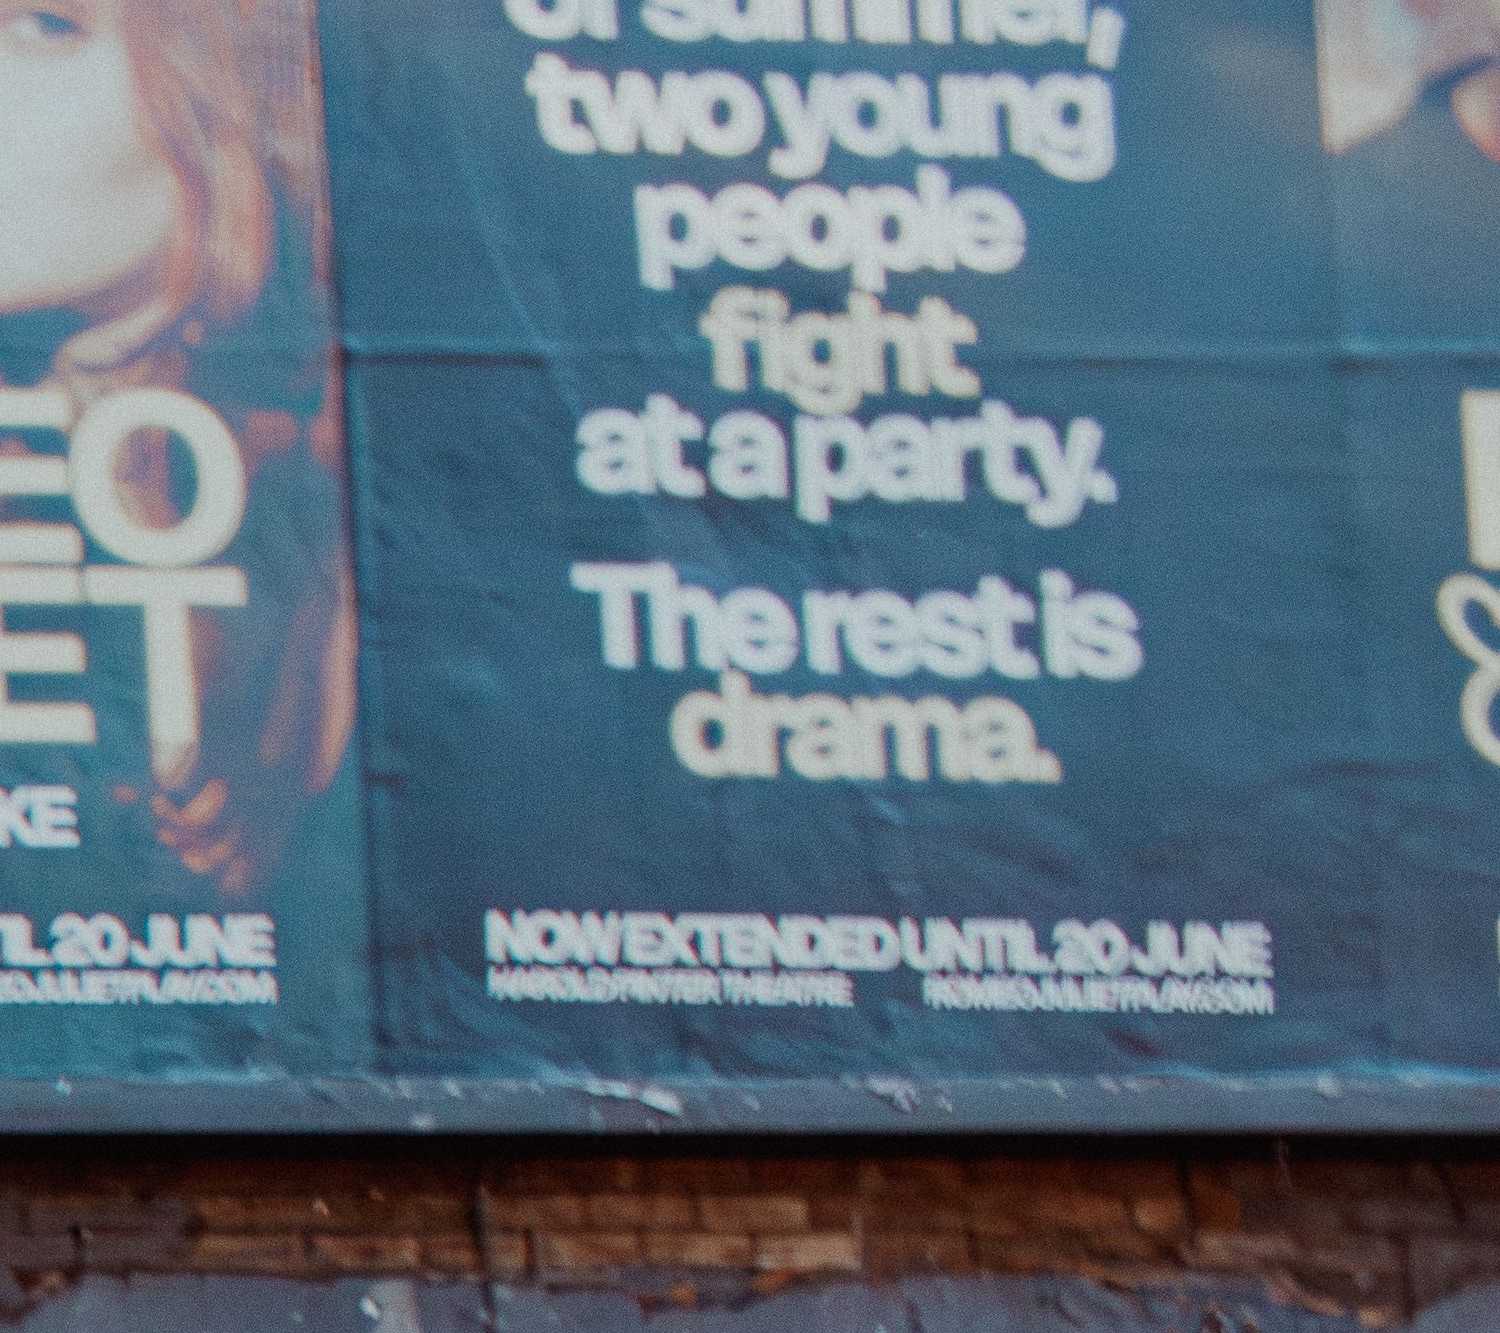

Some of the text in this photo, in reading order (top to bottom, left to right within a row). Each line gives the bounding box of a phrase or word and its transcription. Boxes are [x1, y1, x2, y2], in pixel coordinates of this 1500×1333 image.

[524, 50, 1117, 183] two young
[632, 164, 1027, 293] people
[699, 286, 982, 418] fight
[575, 394, 1120, 528] at a party.
[570, 561, 1146, 682] The rest is
[670, 667, 1063, 783] drama.
[48, 913, 132, 968] 20
[129, 913, 279, 970] JUNE
[485, 908, 1274, 979] NOW EXTENDED UNTIL 20 JUNE
